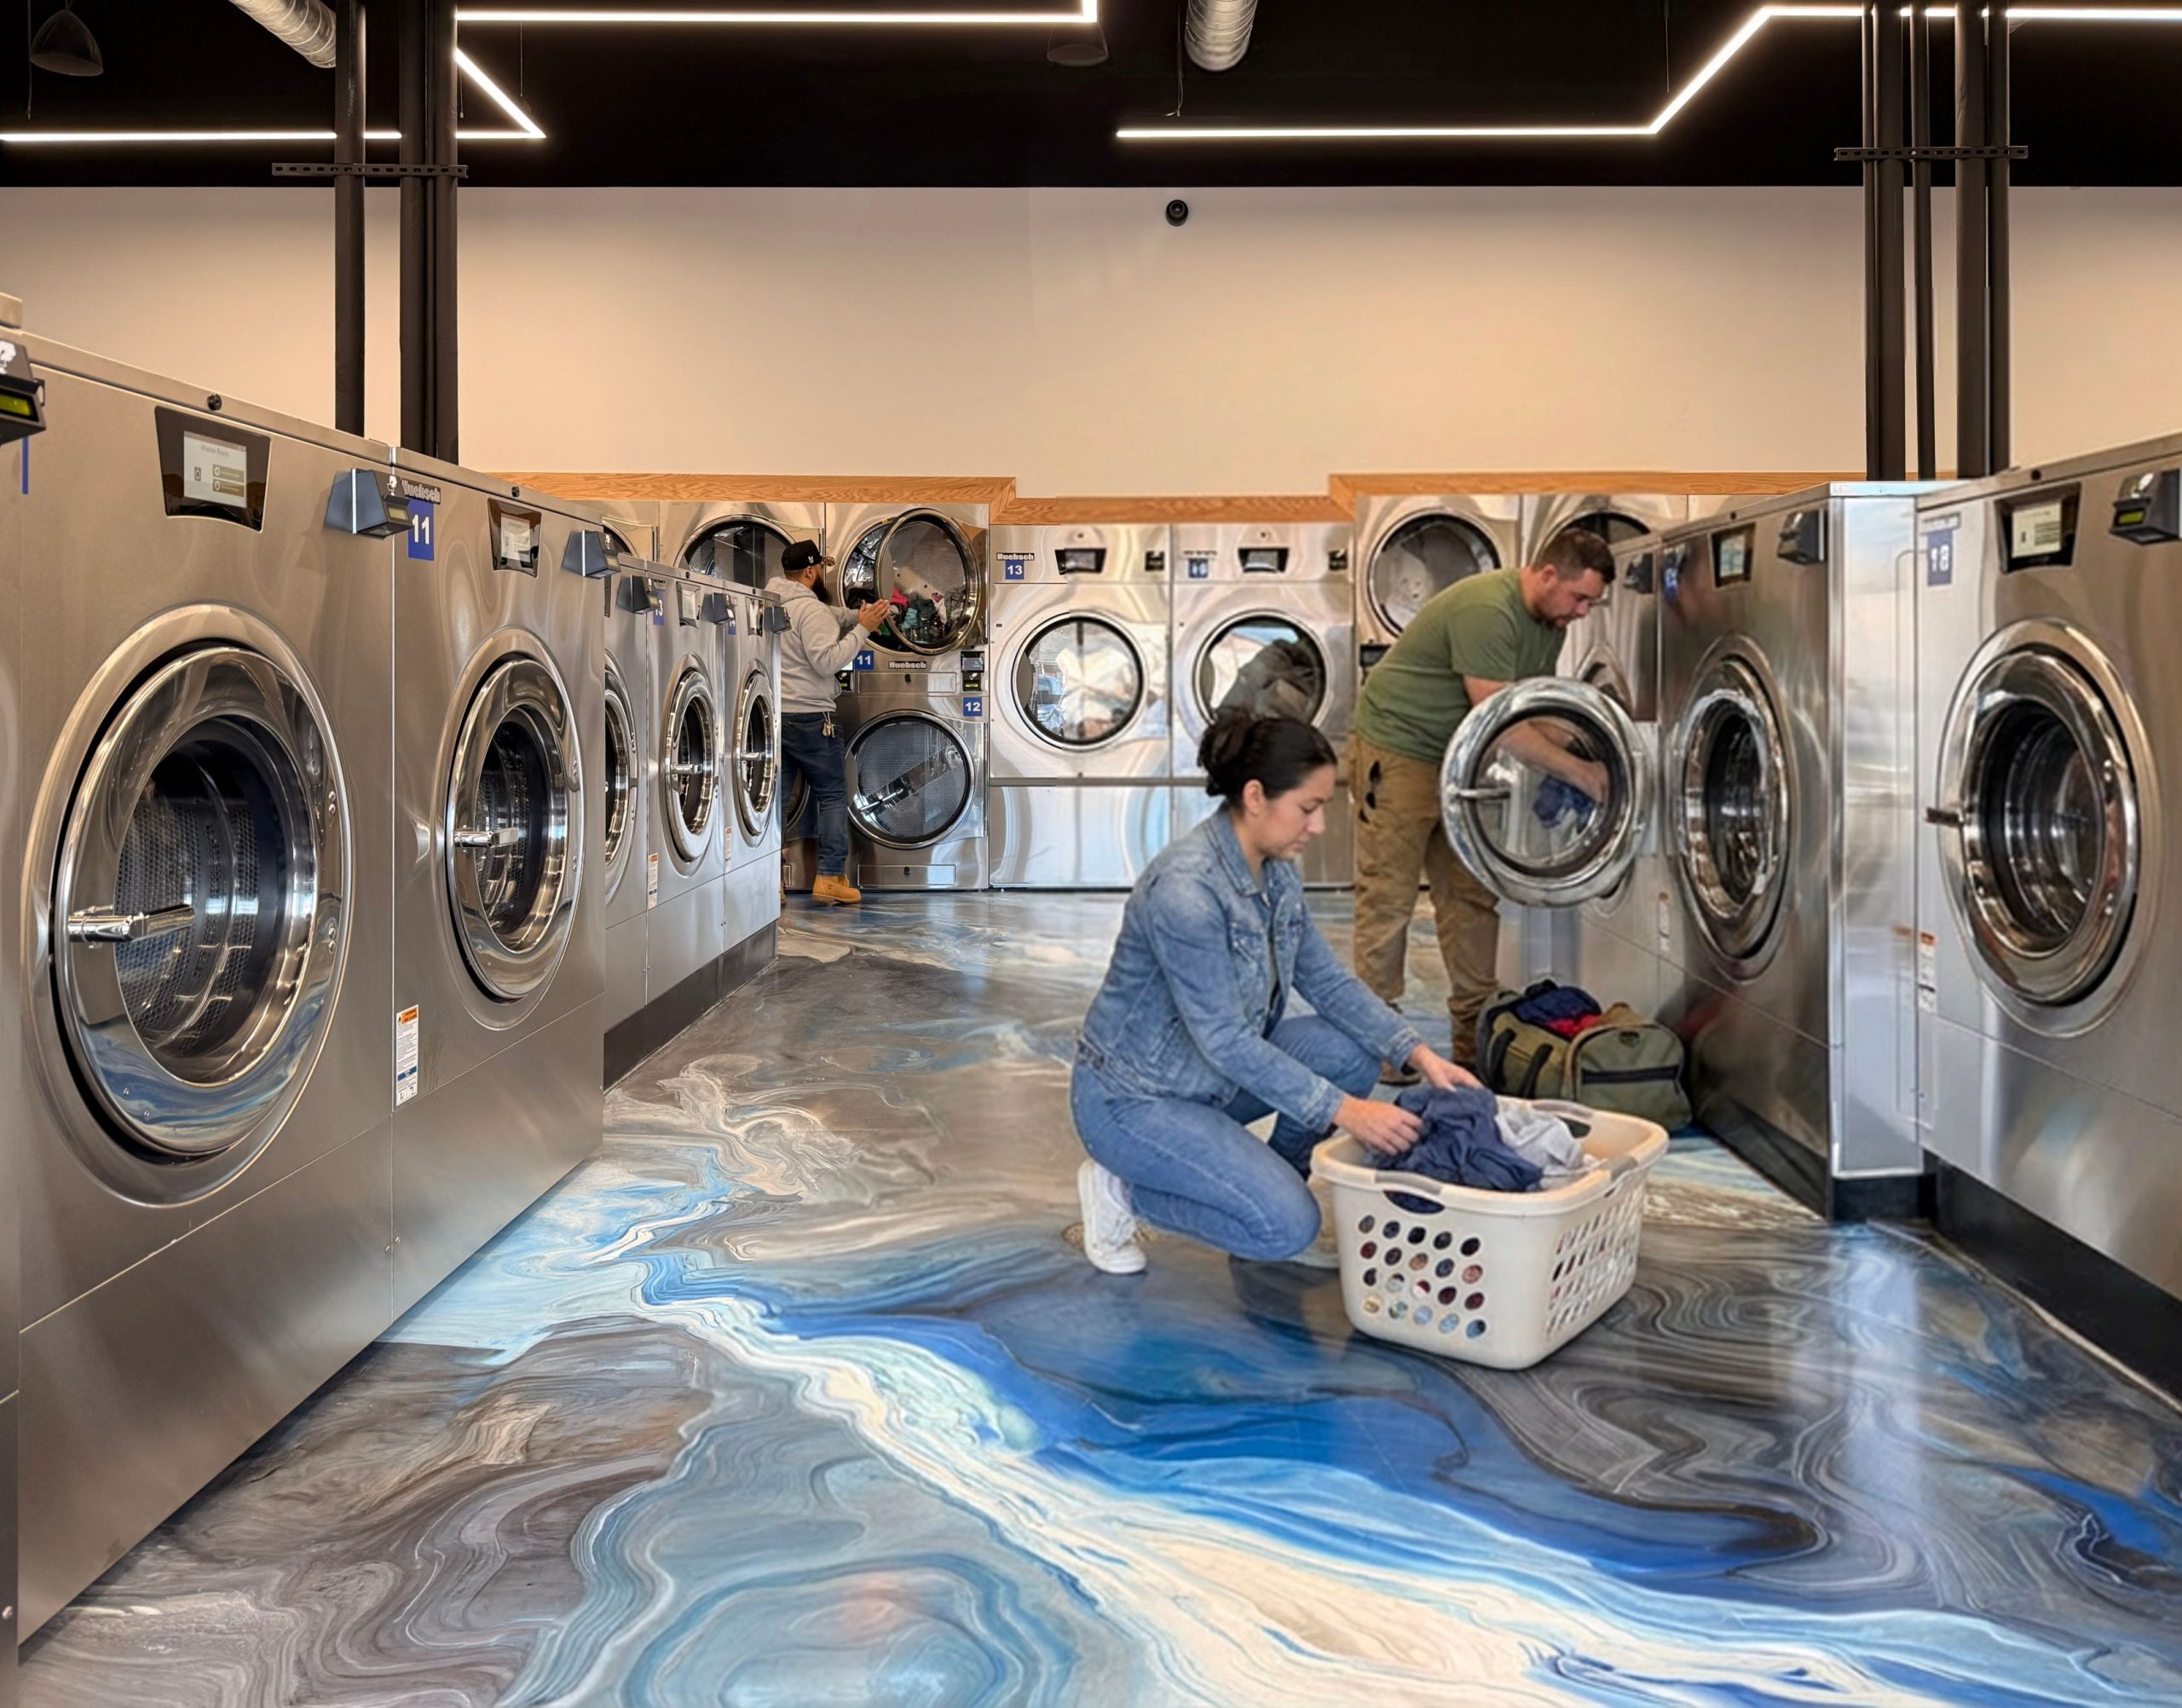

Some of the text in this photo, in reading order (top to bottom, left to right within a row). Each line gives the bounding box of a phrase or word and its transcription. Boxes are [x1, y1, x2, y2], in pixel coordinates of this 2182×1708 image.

[412, 514, 430, 545] 11
[1931, 544, 1950, 572] 18
[1007, 564, 1023, 575] 13
[857, 655, 871, 666] 11
[965, 701, 981, 712] 12
